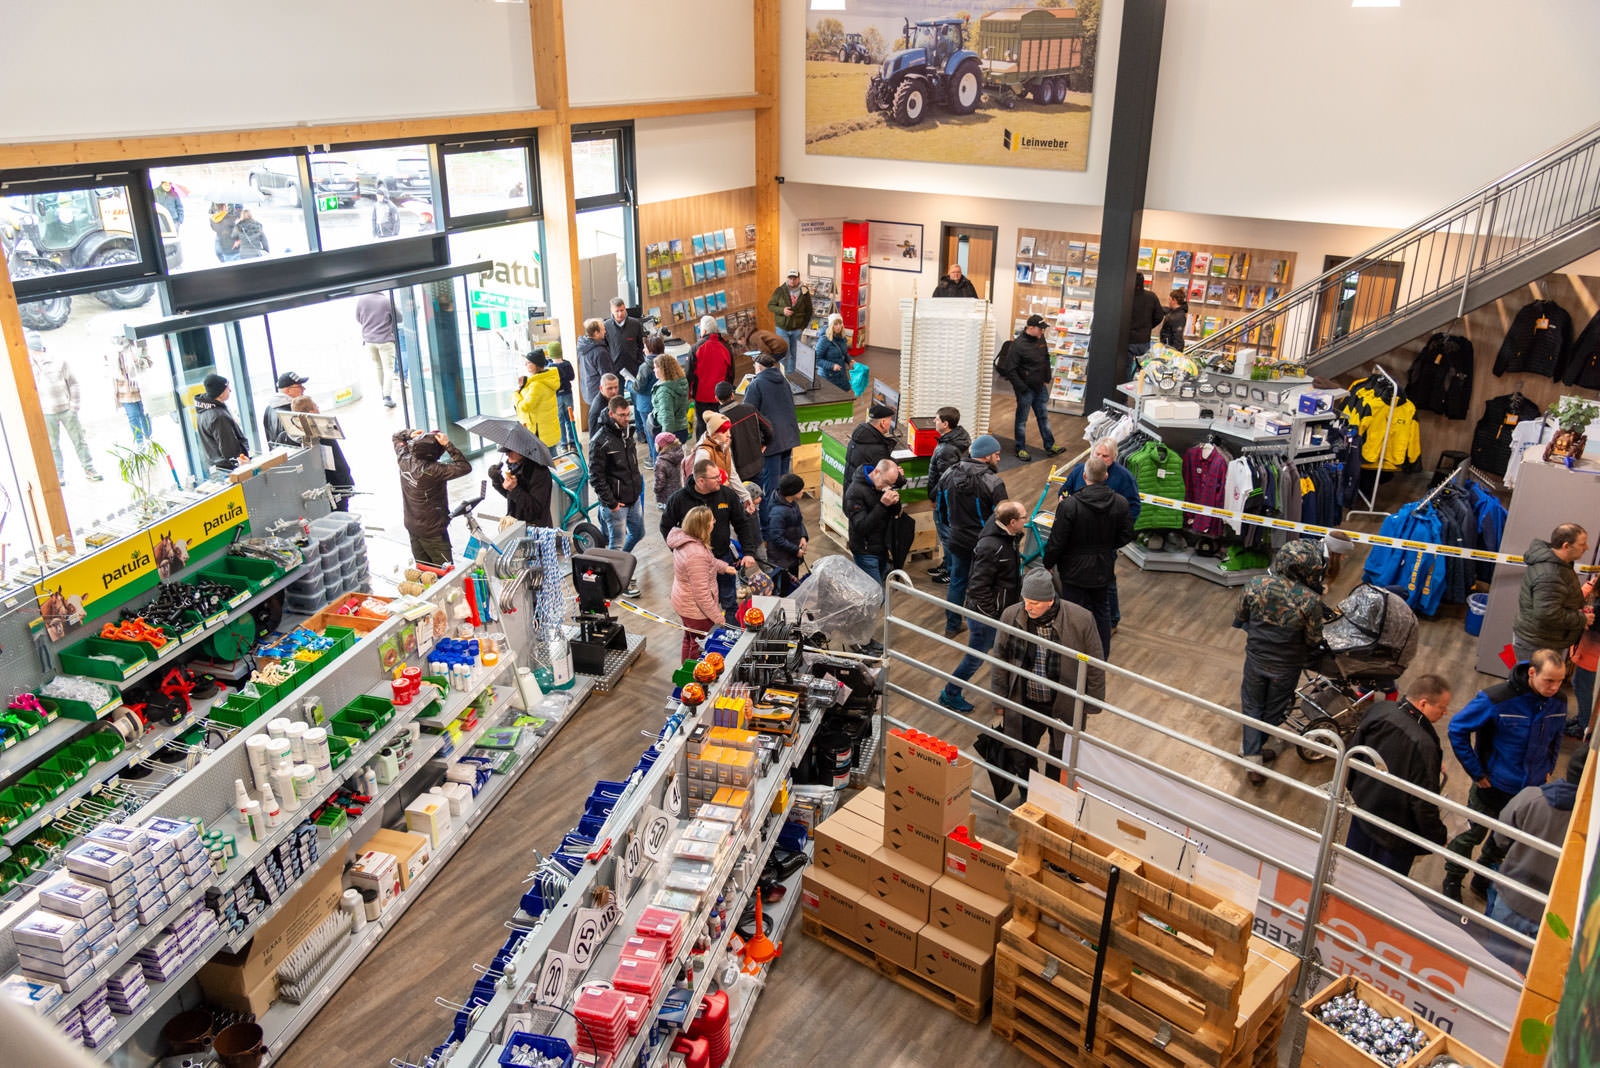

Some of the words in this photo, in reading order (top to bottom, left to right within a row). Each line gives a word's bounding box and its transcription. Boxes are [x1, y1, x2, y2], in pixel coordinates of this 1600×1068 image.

[1021, 136, 1069, 149] Leinweber
[203, 504, 244, 536] patura
[102, 552, 151, 590] patura
[649, 821, 666, 849] 50
[628, 842, 640, 874] 30
[577, 928, 595, 956] 25
[544, 965, 561, 997] 20
